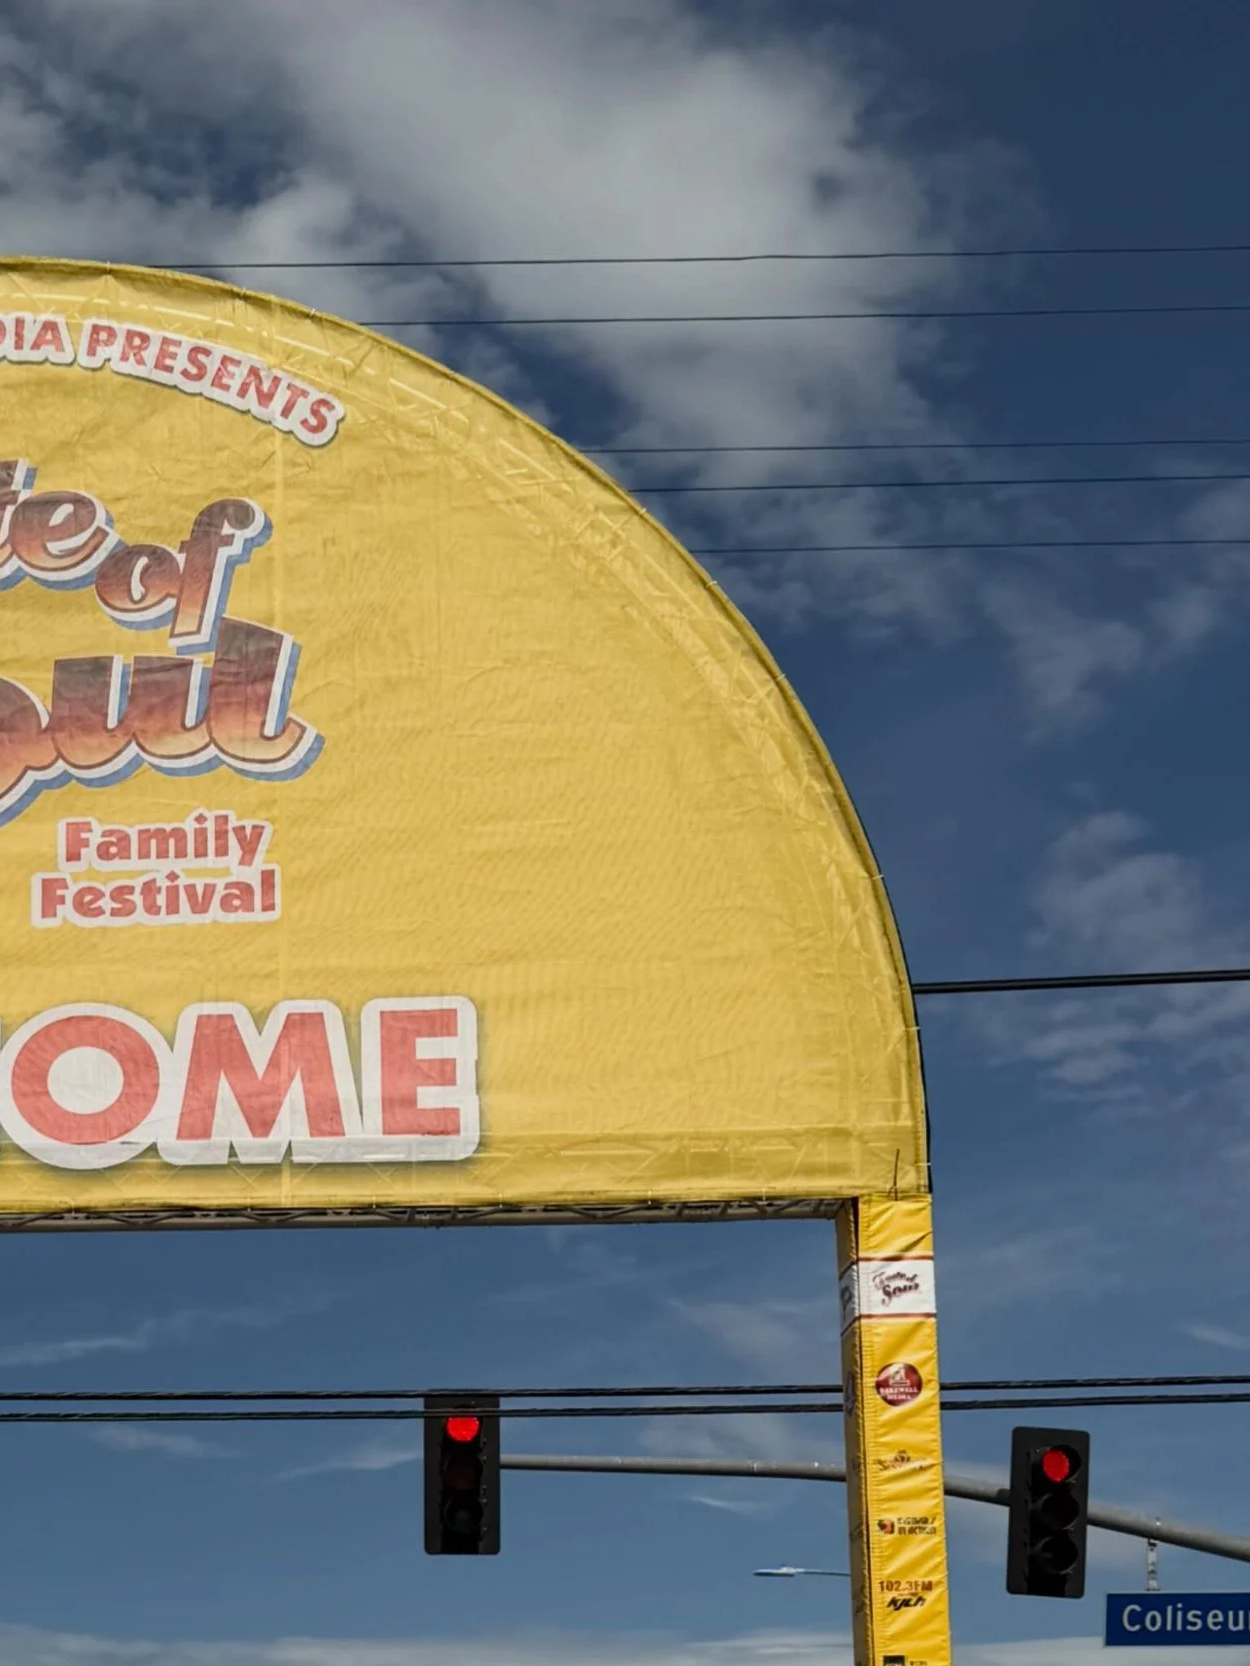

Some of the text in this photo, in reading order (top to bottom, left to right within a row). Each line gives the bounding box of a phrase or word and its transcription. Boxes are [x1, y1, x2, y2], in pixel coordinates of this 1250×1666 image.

[85, 322, 339, 438] PRESENTS
[96, 497, 266, 645] of
[64, 813, 267, 868] Family
[38, 870, 277, 920] Festival
[1122, 1602, 1250, 1632] Coliseu
